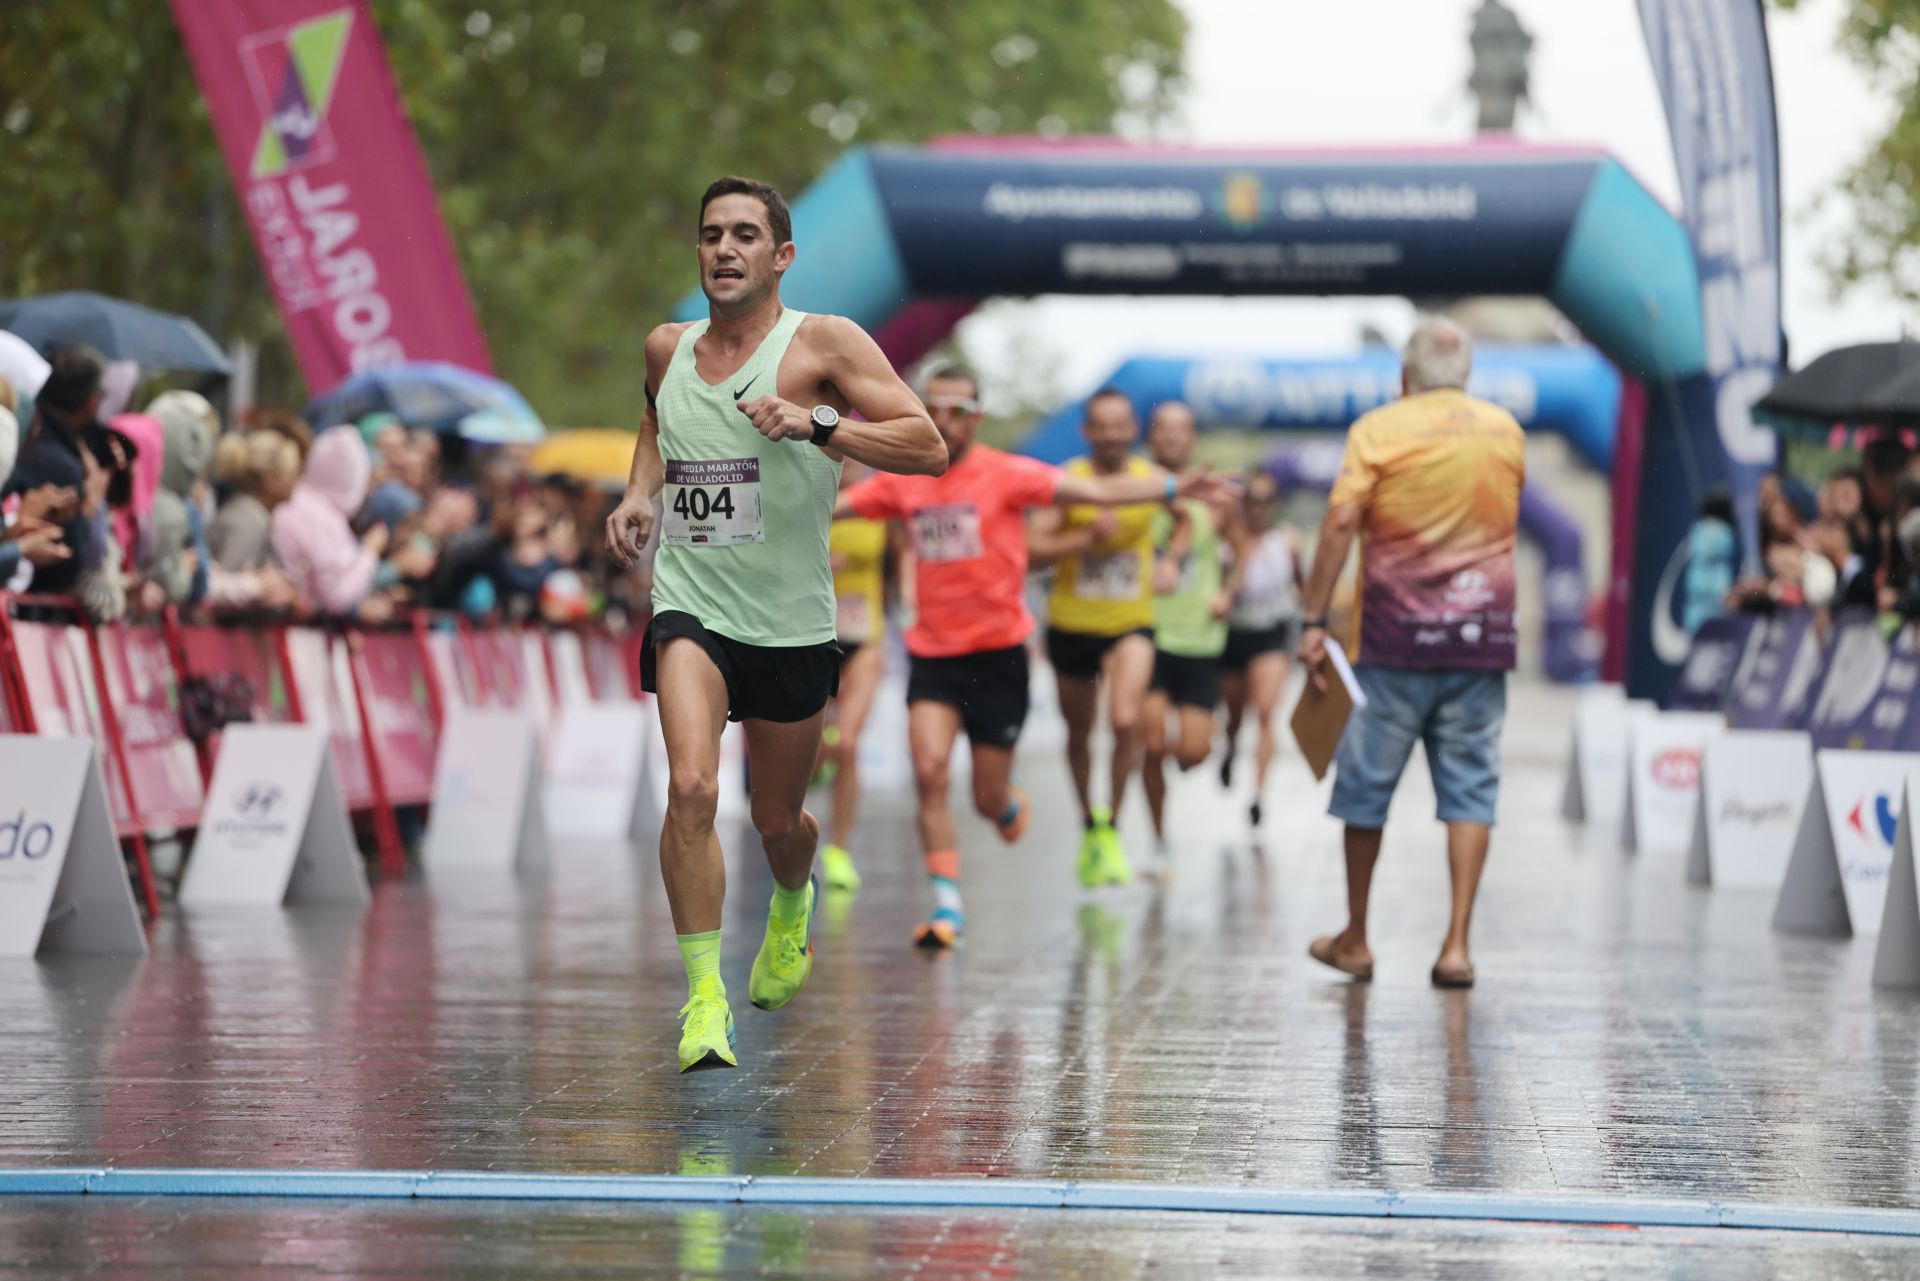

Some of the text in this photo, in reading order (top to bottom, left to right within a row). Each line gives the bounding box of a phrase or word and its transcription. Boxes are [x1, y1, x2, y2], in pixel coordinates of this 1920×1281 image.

[680, 464, 705, 474] MEDIA
[707, 460, 757, 473] MARATÓN
[676, 473, 744, 484] DE VALLADOLID
[673, 486, 735, 521] 404
